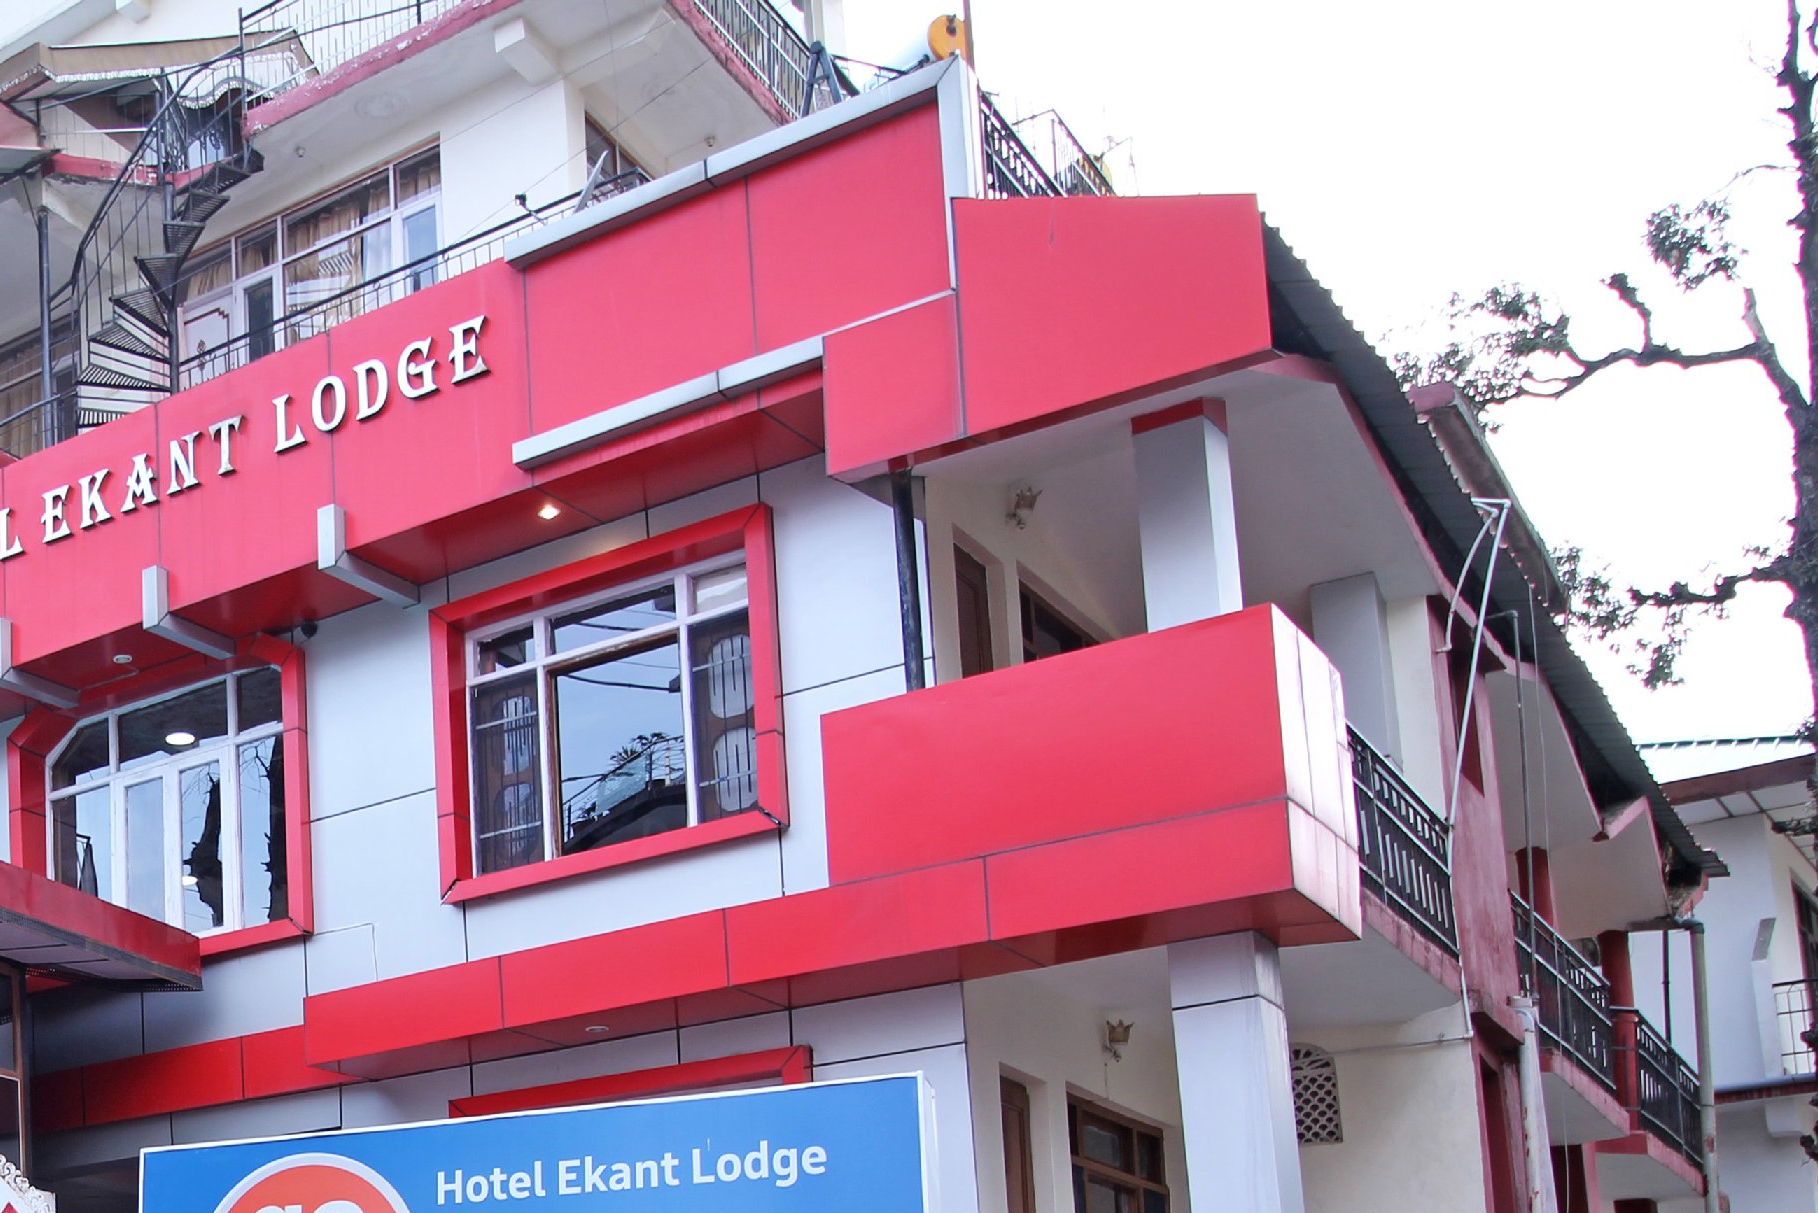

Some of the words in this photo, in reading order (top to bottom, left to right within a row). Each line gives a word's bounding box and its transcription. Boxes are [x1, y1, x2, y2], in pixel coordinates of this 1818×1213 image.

[40, 413, 244, 545] EKANT
[273, 314, 491, 455] LODGE
[436, 1160, 546, 1205] Hotel
[558, 1149, 680, 1197] Ekant
[691, 1139, 828, 1188] Lodge
